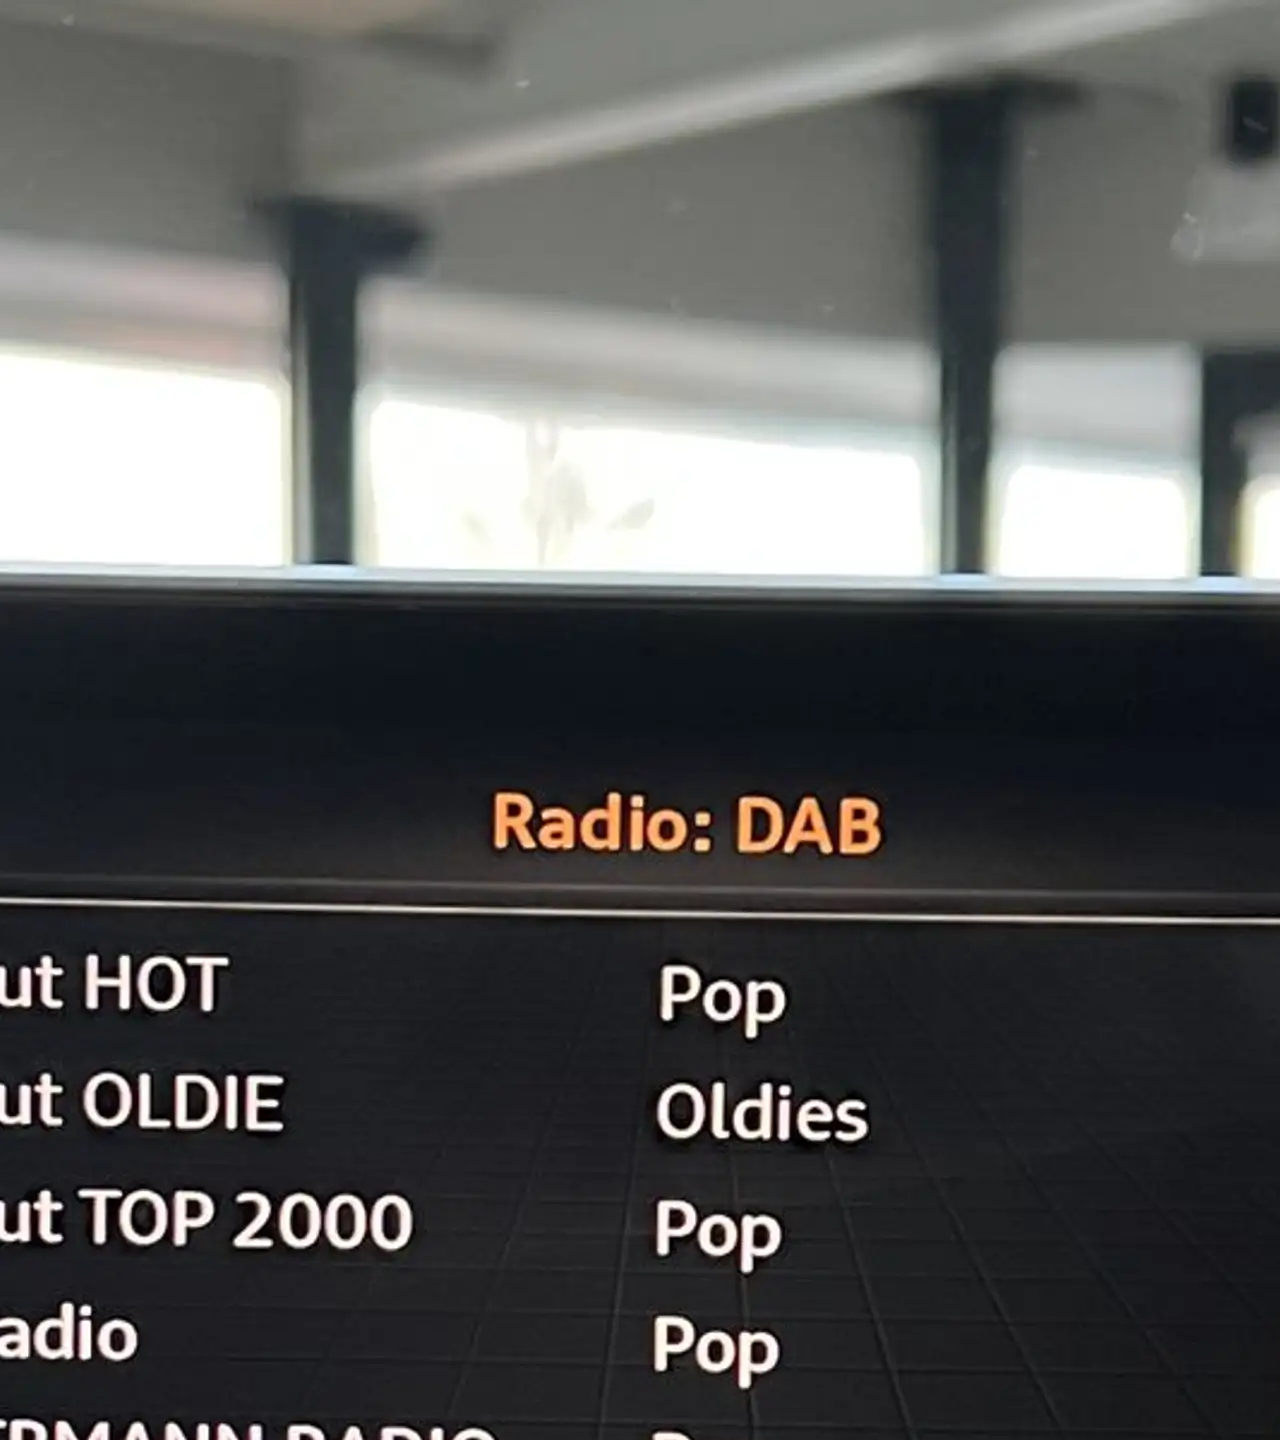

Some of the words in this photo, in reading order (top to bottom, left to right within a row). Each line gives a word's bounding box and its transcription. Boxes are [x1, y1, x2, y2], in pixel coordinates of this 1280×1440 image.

[494, 792, 711, 852] Radio:
[737, 796, 881, 855] DAB
[85, 954, 229, 1012] HOT
[660, 965, 786, 1039] Pop
[83, 1072, 284, 1132] OLDIE
[657, 1081, 869, 1142] Oldies
[77, 1188, 215, 1247] TOP
[233, 1191, 413, 1251] 2000
[656, 1199, 782, 1274] Pop
[654, 1315, 779, 1390] Pop
